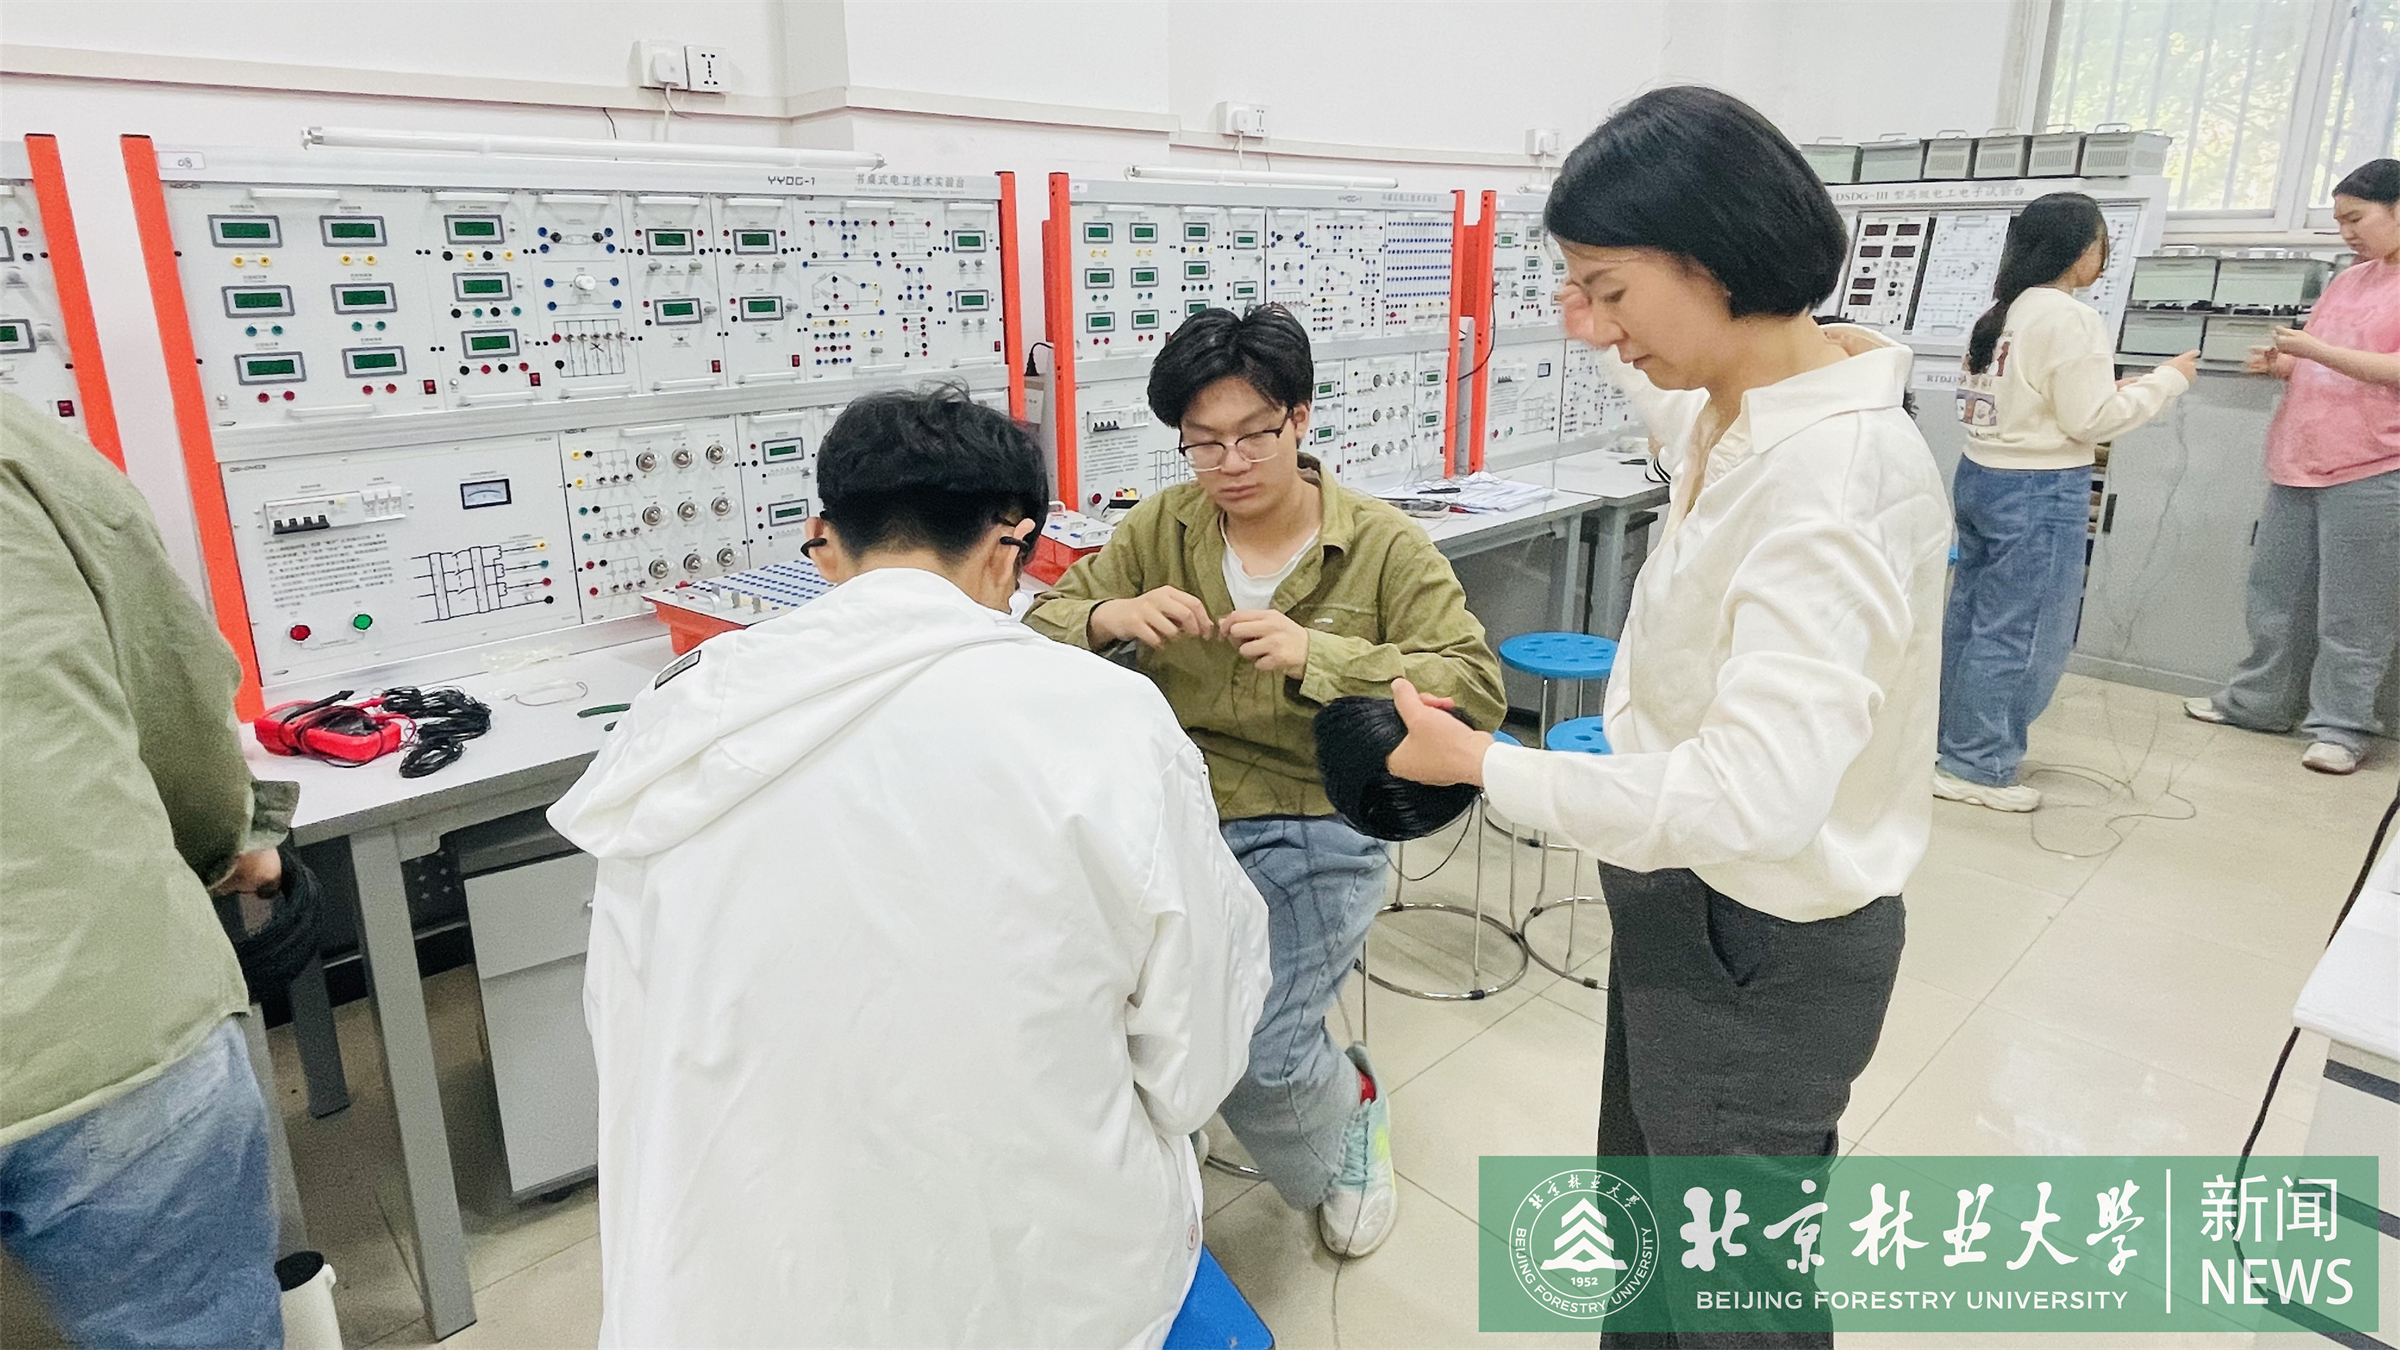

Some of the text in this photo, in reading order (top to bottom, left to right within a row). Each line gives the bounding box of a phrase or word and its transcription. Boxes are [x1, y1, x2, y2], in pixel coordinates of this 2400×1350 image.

[177, 157, 193, 169] 08
[856, 173, 965, 188] 书桌式电工技术实验台
